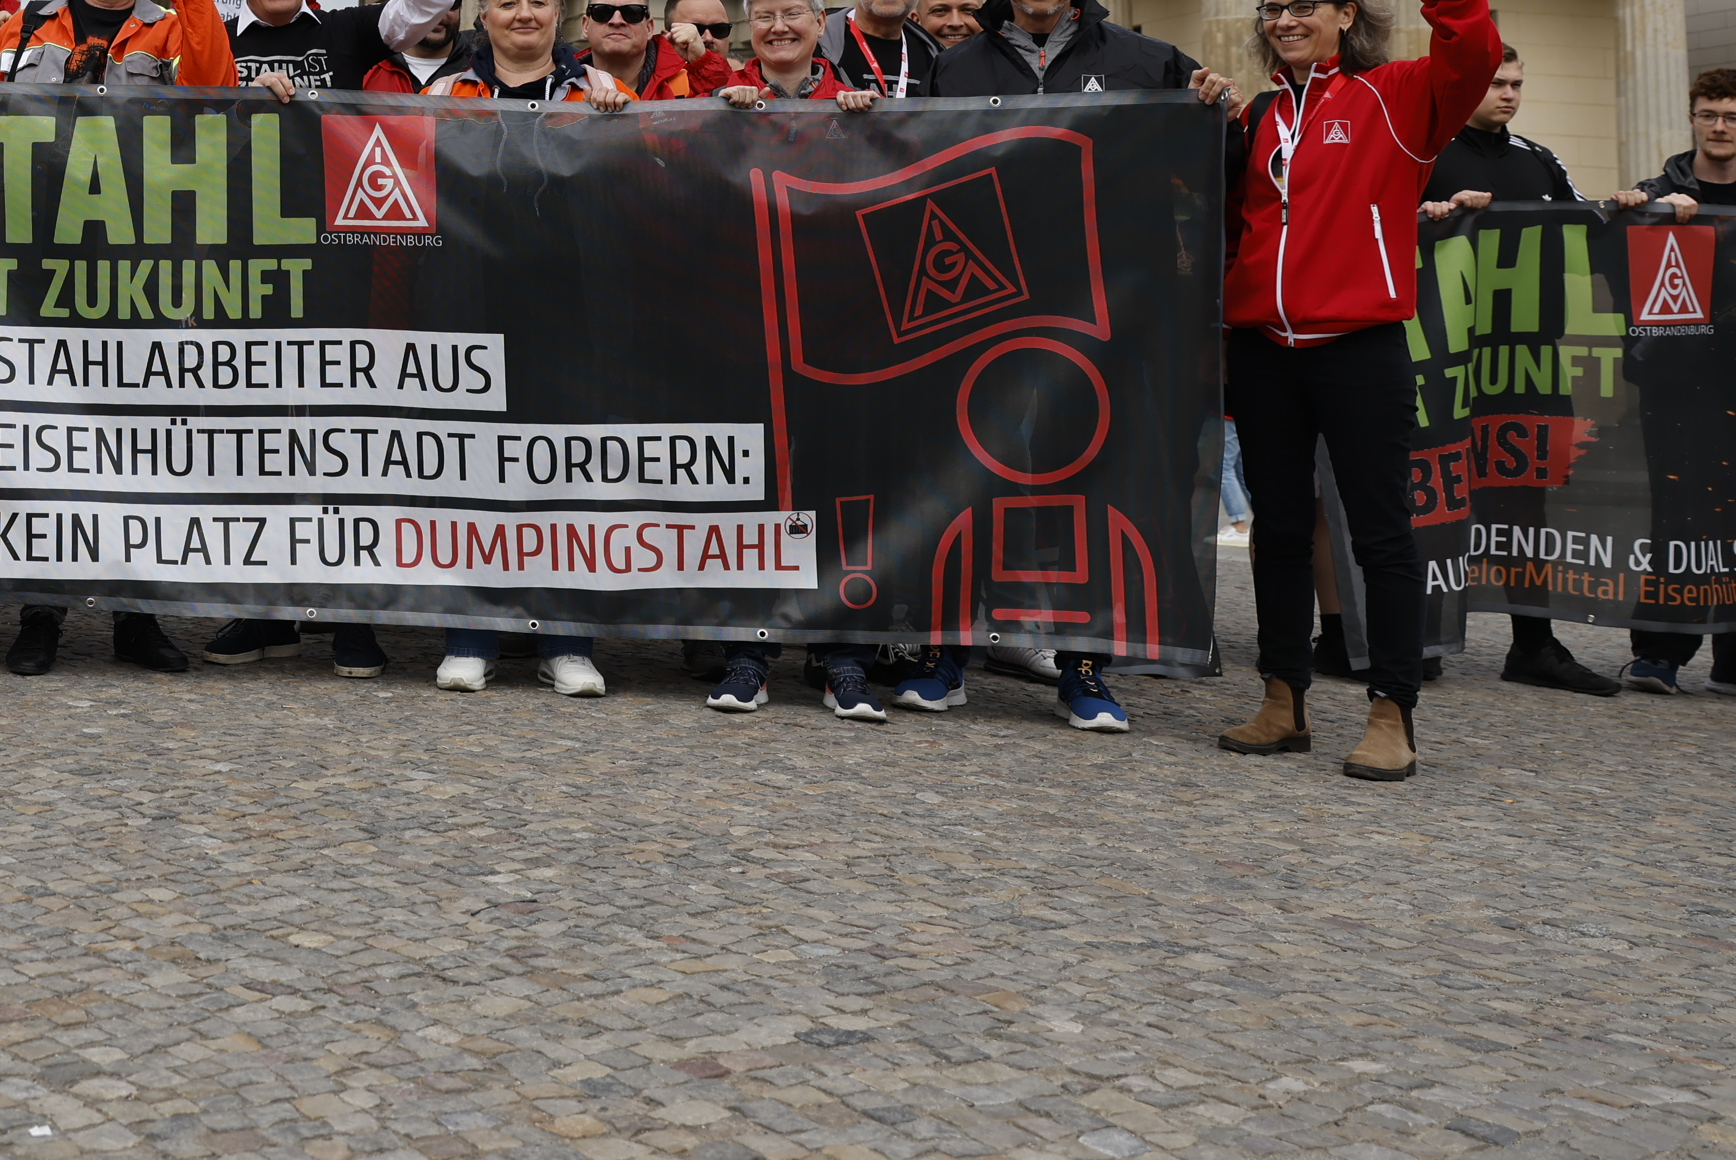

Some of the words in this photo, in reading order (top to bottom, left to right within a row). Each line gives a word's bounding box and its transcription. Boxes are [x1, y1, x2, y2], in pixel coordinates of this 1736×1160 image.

[304, 55, 328, 72] IST
[320, 233, 443, 247] OSTBRANDENBURG
[40, 258, 313, 320] ZUKUNFT
[1628, 325, 1714, 337] OSTBRANDENBURG
[397, 343, 492, 394] AUS
[497, 434, 750, 485] FORDERN:
[122, 515, 268, 566] PLATZ
[289, 507, 382, 566] FÜR
[395, 518, 800, 574] DUMPINGSTAHL
[1628, 538, 1653, 572] &
